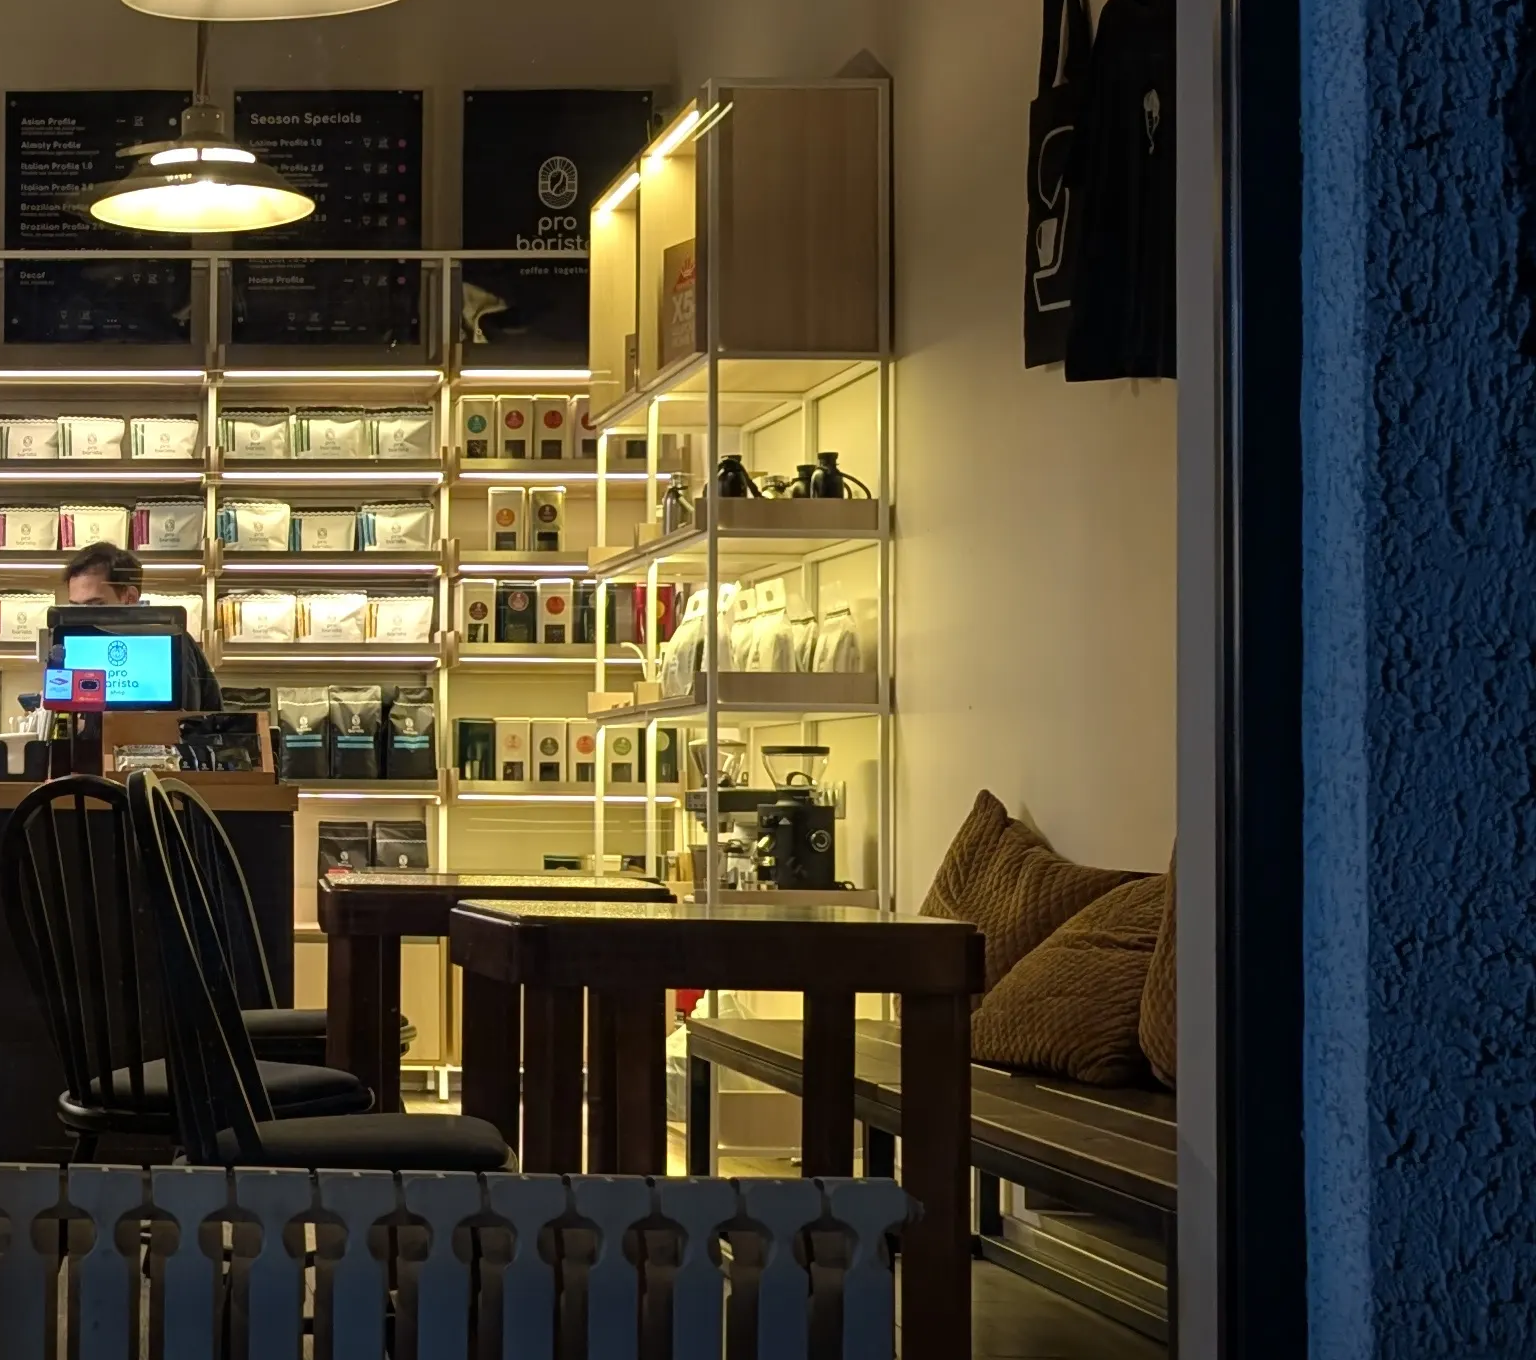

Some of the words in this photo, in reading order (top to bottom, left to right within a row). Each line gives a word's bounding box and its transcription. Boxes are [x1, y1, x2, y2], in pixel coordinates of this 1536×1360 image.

[48, 117, 77, 127] Profile
[250, 113, 300, 125] Season
[304, 112, 362, 127] Specials
[52, 141, 82, 150] Profile
[280, 138, 309, 147] Profile
[51, 162, 80, 171] Profile
[51, 183, 80, 191] Profile
[20, 222, 60, 231] Brazilian
[62, 222, 90, 231] Profile
[538, 216, 578, 236] pro
[19, 271, 46, 279] Decaf
[276, 276, 305, 284] Profile
[107, 669, 128, 679] pro
[105, 678, 140, 688] arista
